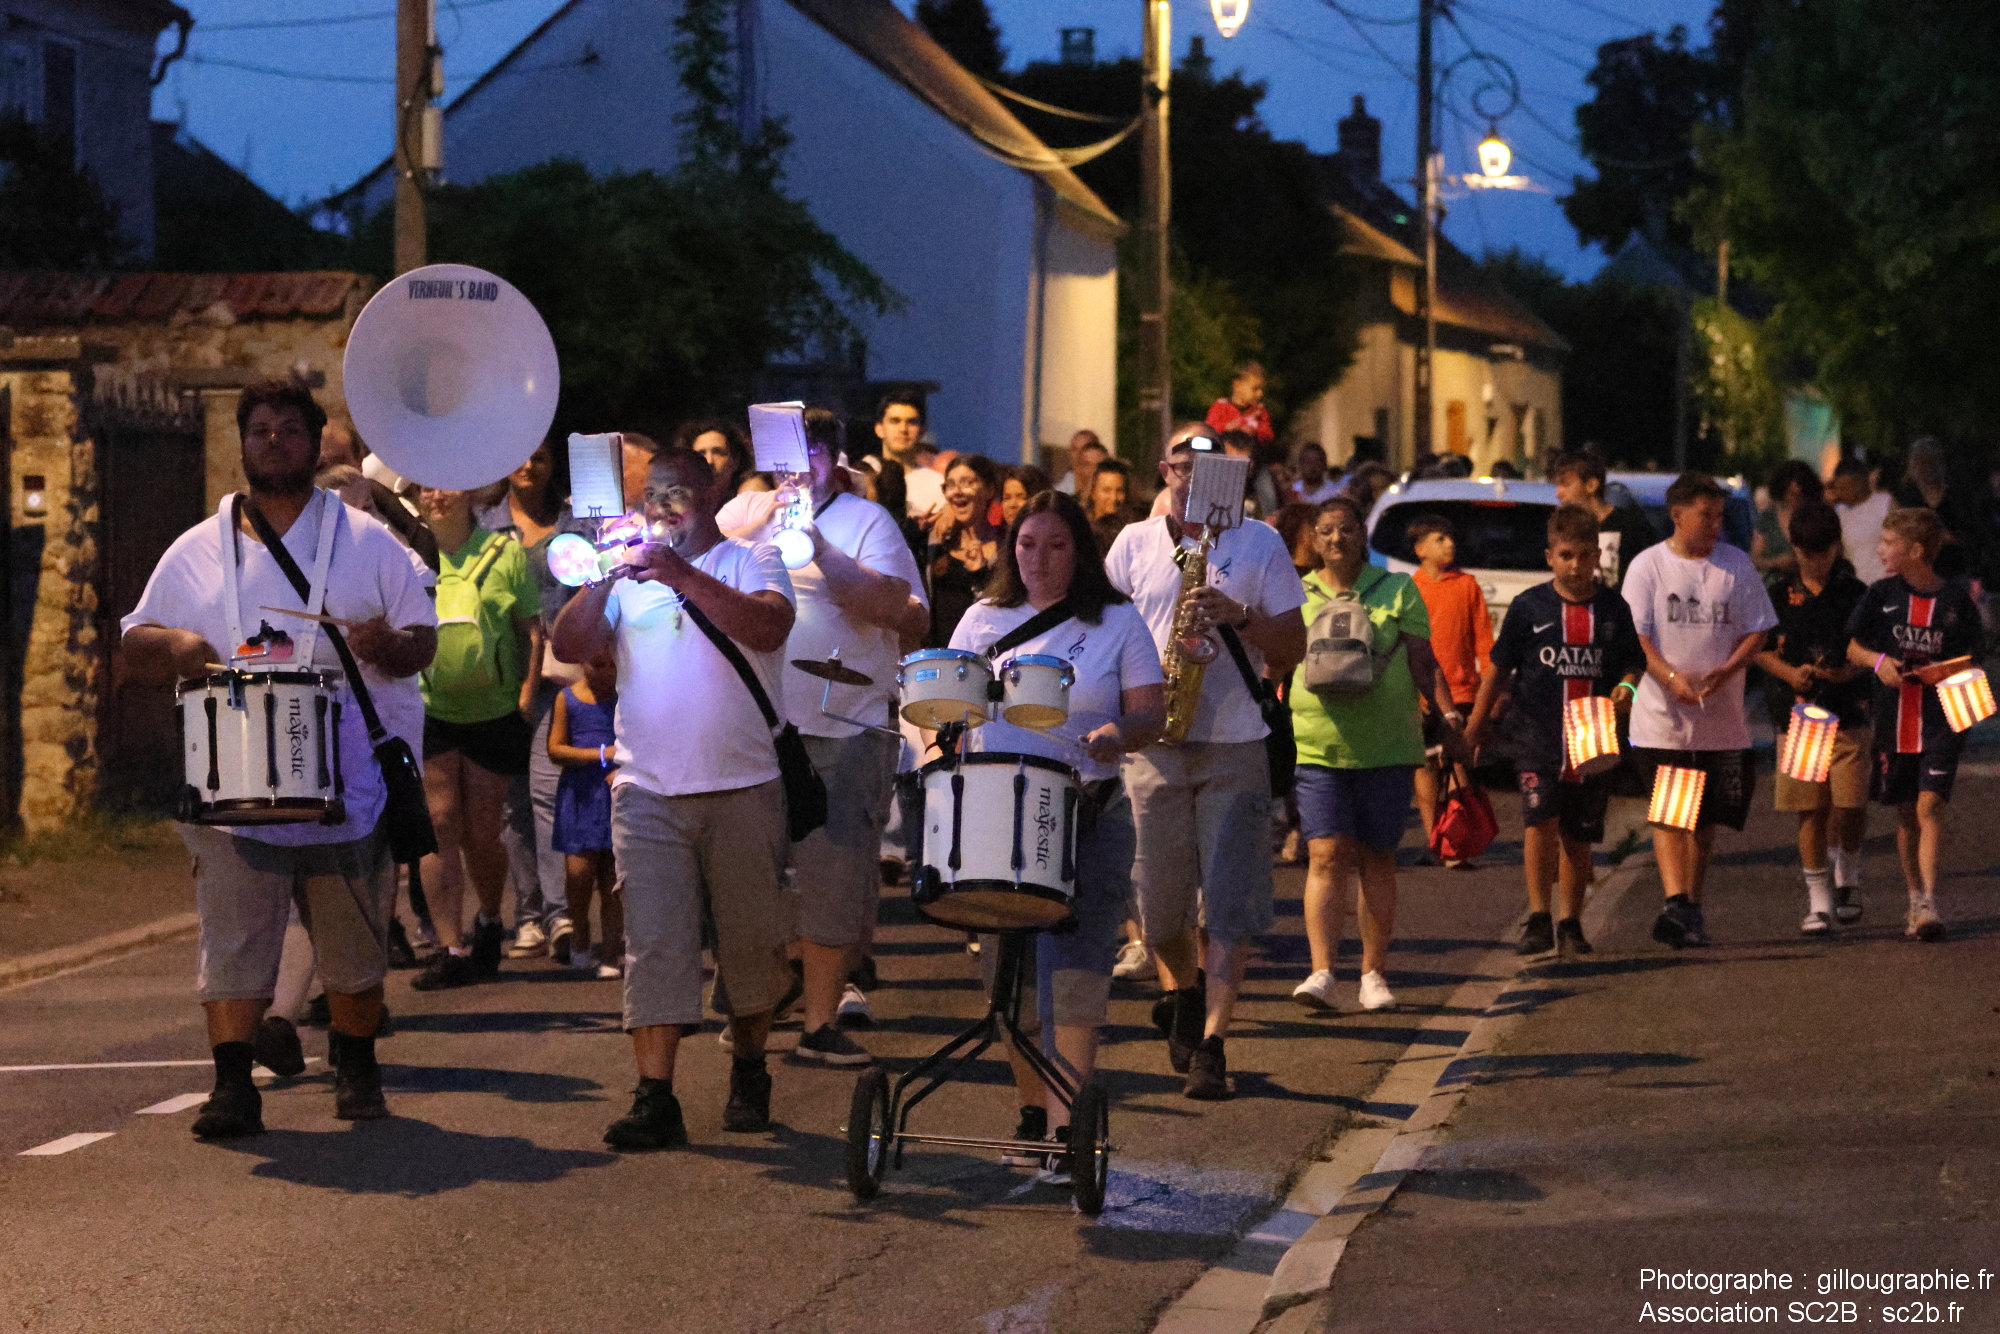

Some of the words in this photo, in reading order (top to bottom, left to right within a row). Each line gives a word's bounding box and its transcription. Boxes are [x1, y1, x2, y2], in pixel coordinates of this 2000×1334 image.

[468, 281, 498, 301] BAND
[1539, 645, 1603, 668] QATAR
[285, 697, 306, 780] majestic
[1034, 787, 1051, 870] majestic
